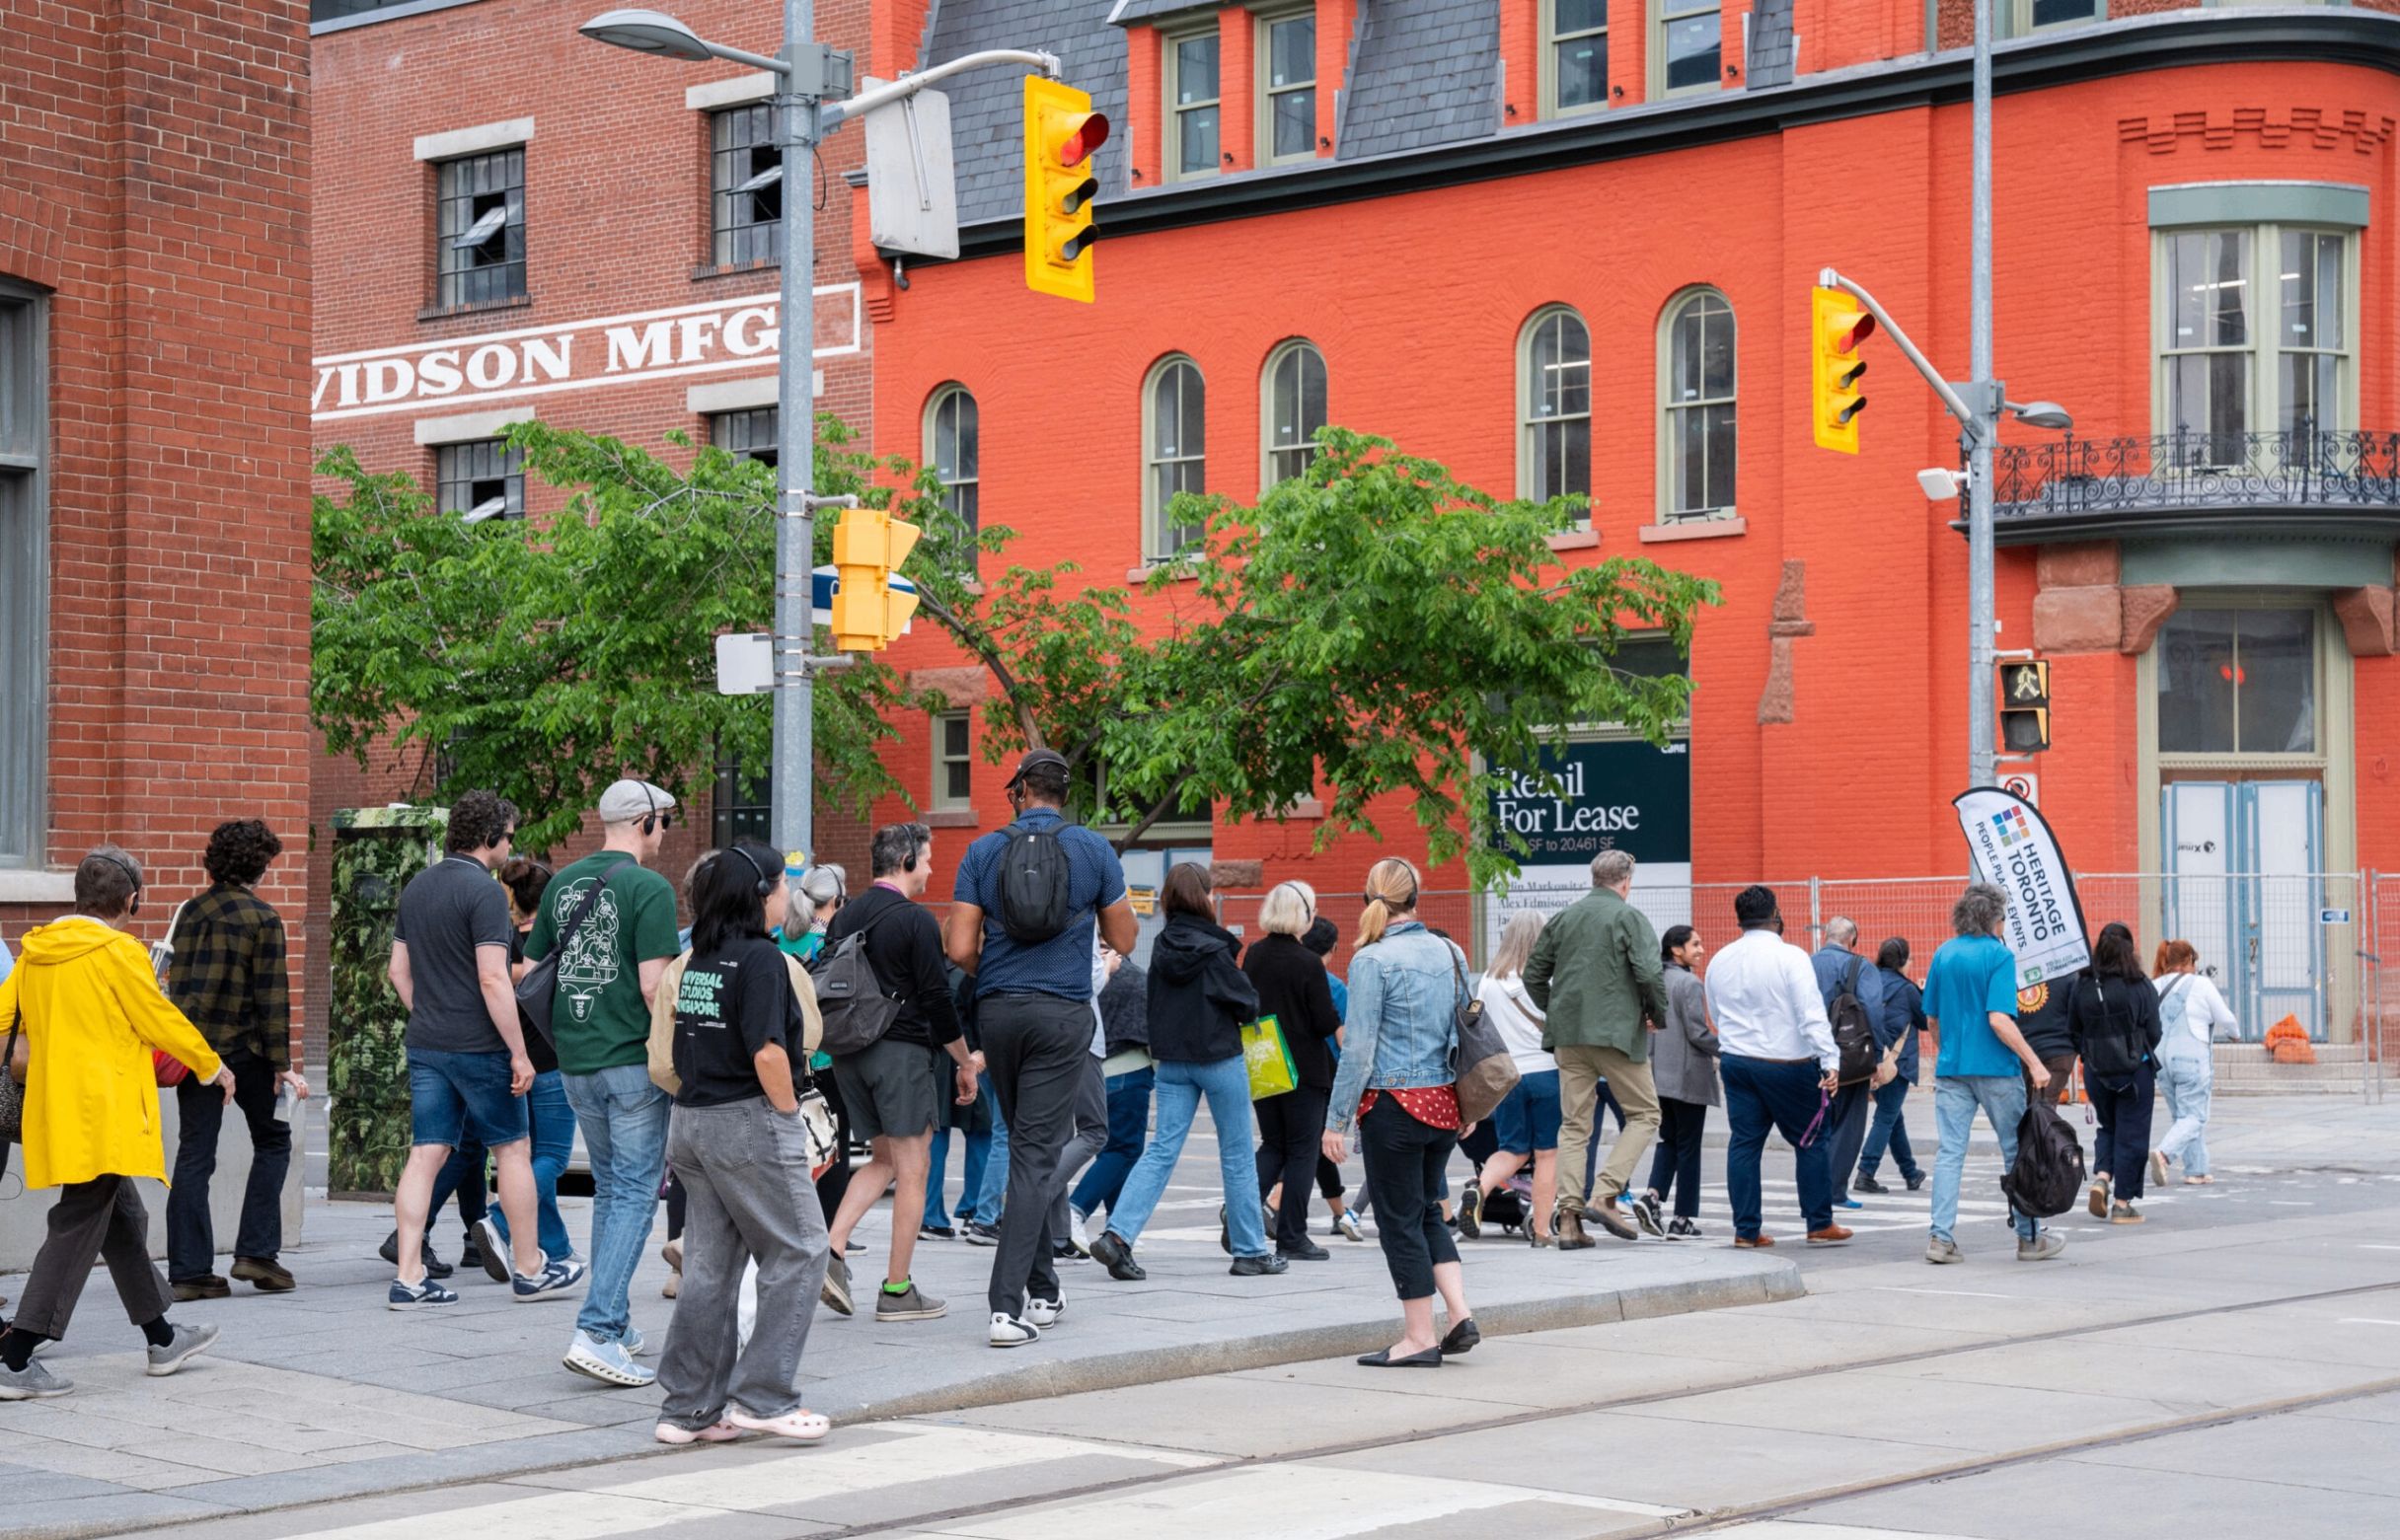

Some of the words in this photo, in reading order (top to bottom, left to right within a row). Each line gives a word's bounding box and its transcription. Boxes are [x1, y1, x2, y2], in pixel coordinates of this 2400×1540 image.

[312, 334, 574, 411] VIDSON
[604, 306, 781, 373] MFG
[1496, 800, 1547, 833] For
[1553, 799, 1640, 833] Lease
[1529, 839, 1543, 851] SF
[1546, 840, 1558, 851] to
[1560, 837, 1597, 851] 20,461
[1600, 837, 1614, 849] SF
[2008, 849, 2048, 941] TORONTO
[2023, 843, 2065, 935] HERITAGE
[680, 986, 714, 1001] STUDIOS
[682, 970, 724, 989] NIVERSAL
